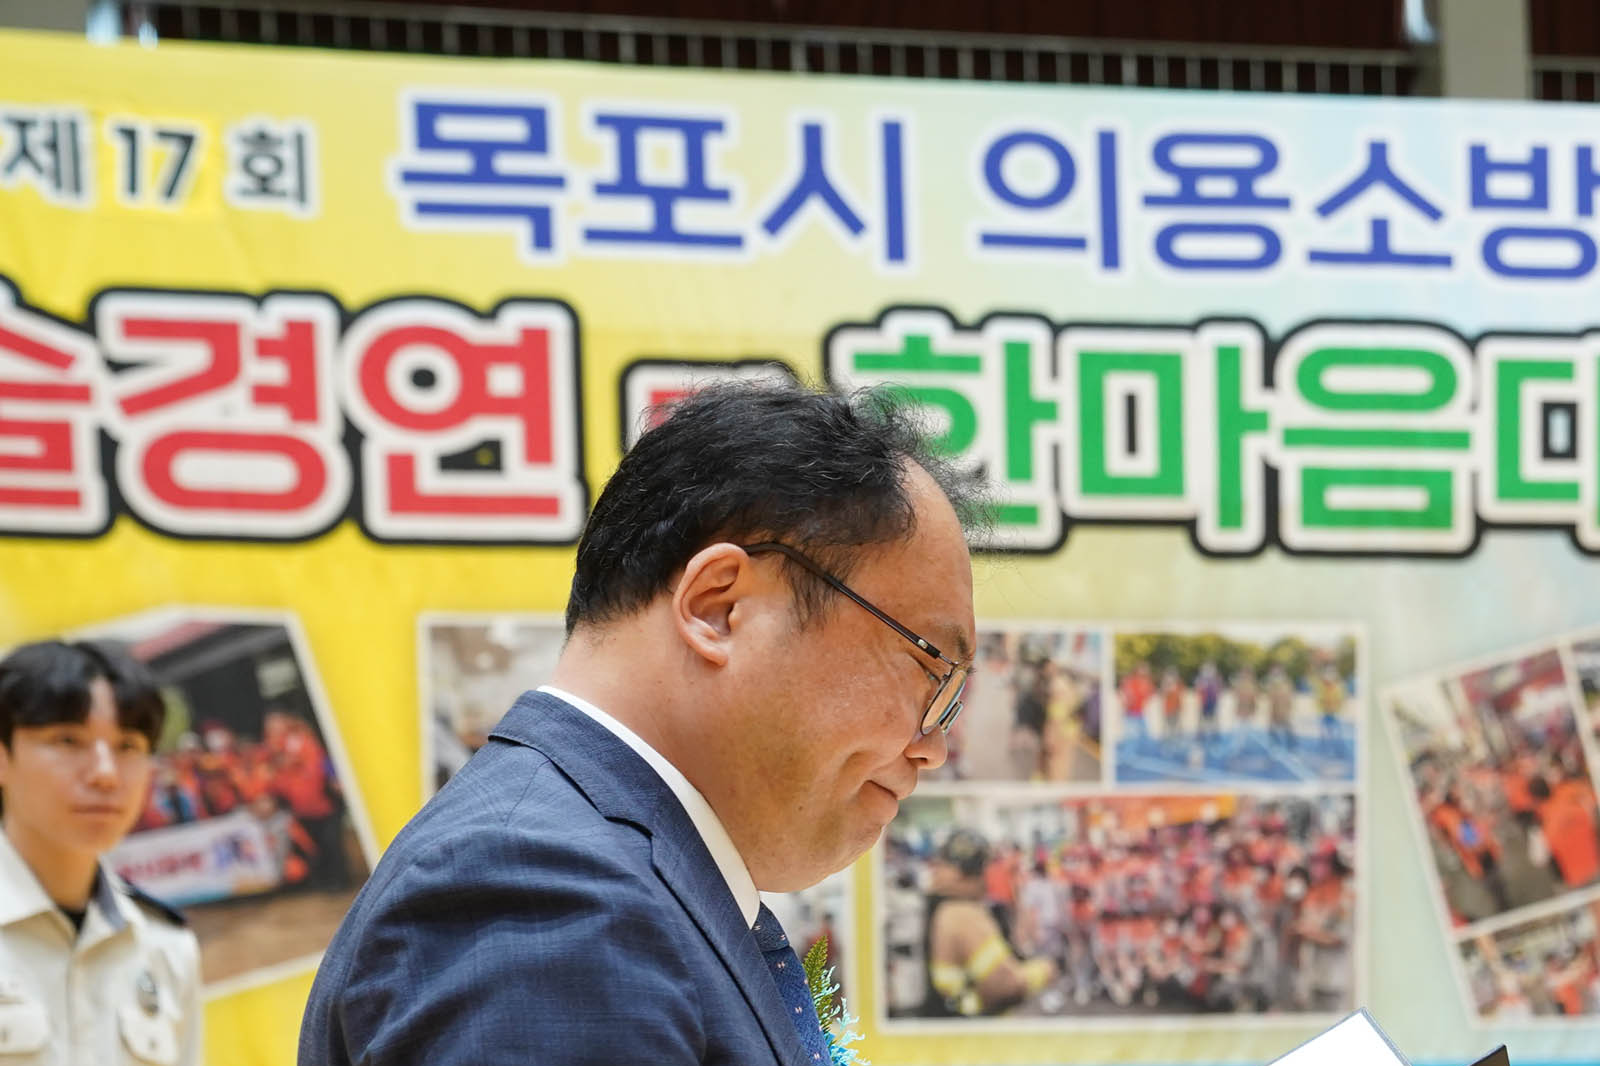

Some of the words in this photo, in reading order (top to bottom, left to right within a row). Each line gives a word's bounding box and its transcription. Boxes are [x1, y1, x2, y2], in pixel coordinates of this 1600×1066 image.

[4, 116, 81, 194] 제
[117, 127, 195, 198] 17
[238, 129, 308, 207] 회
[402, 100, 906, 263] 목포시
